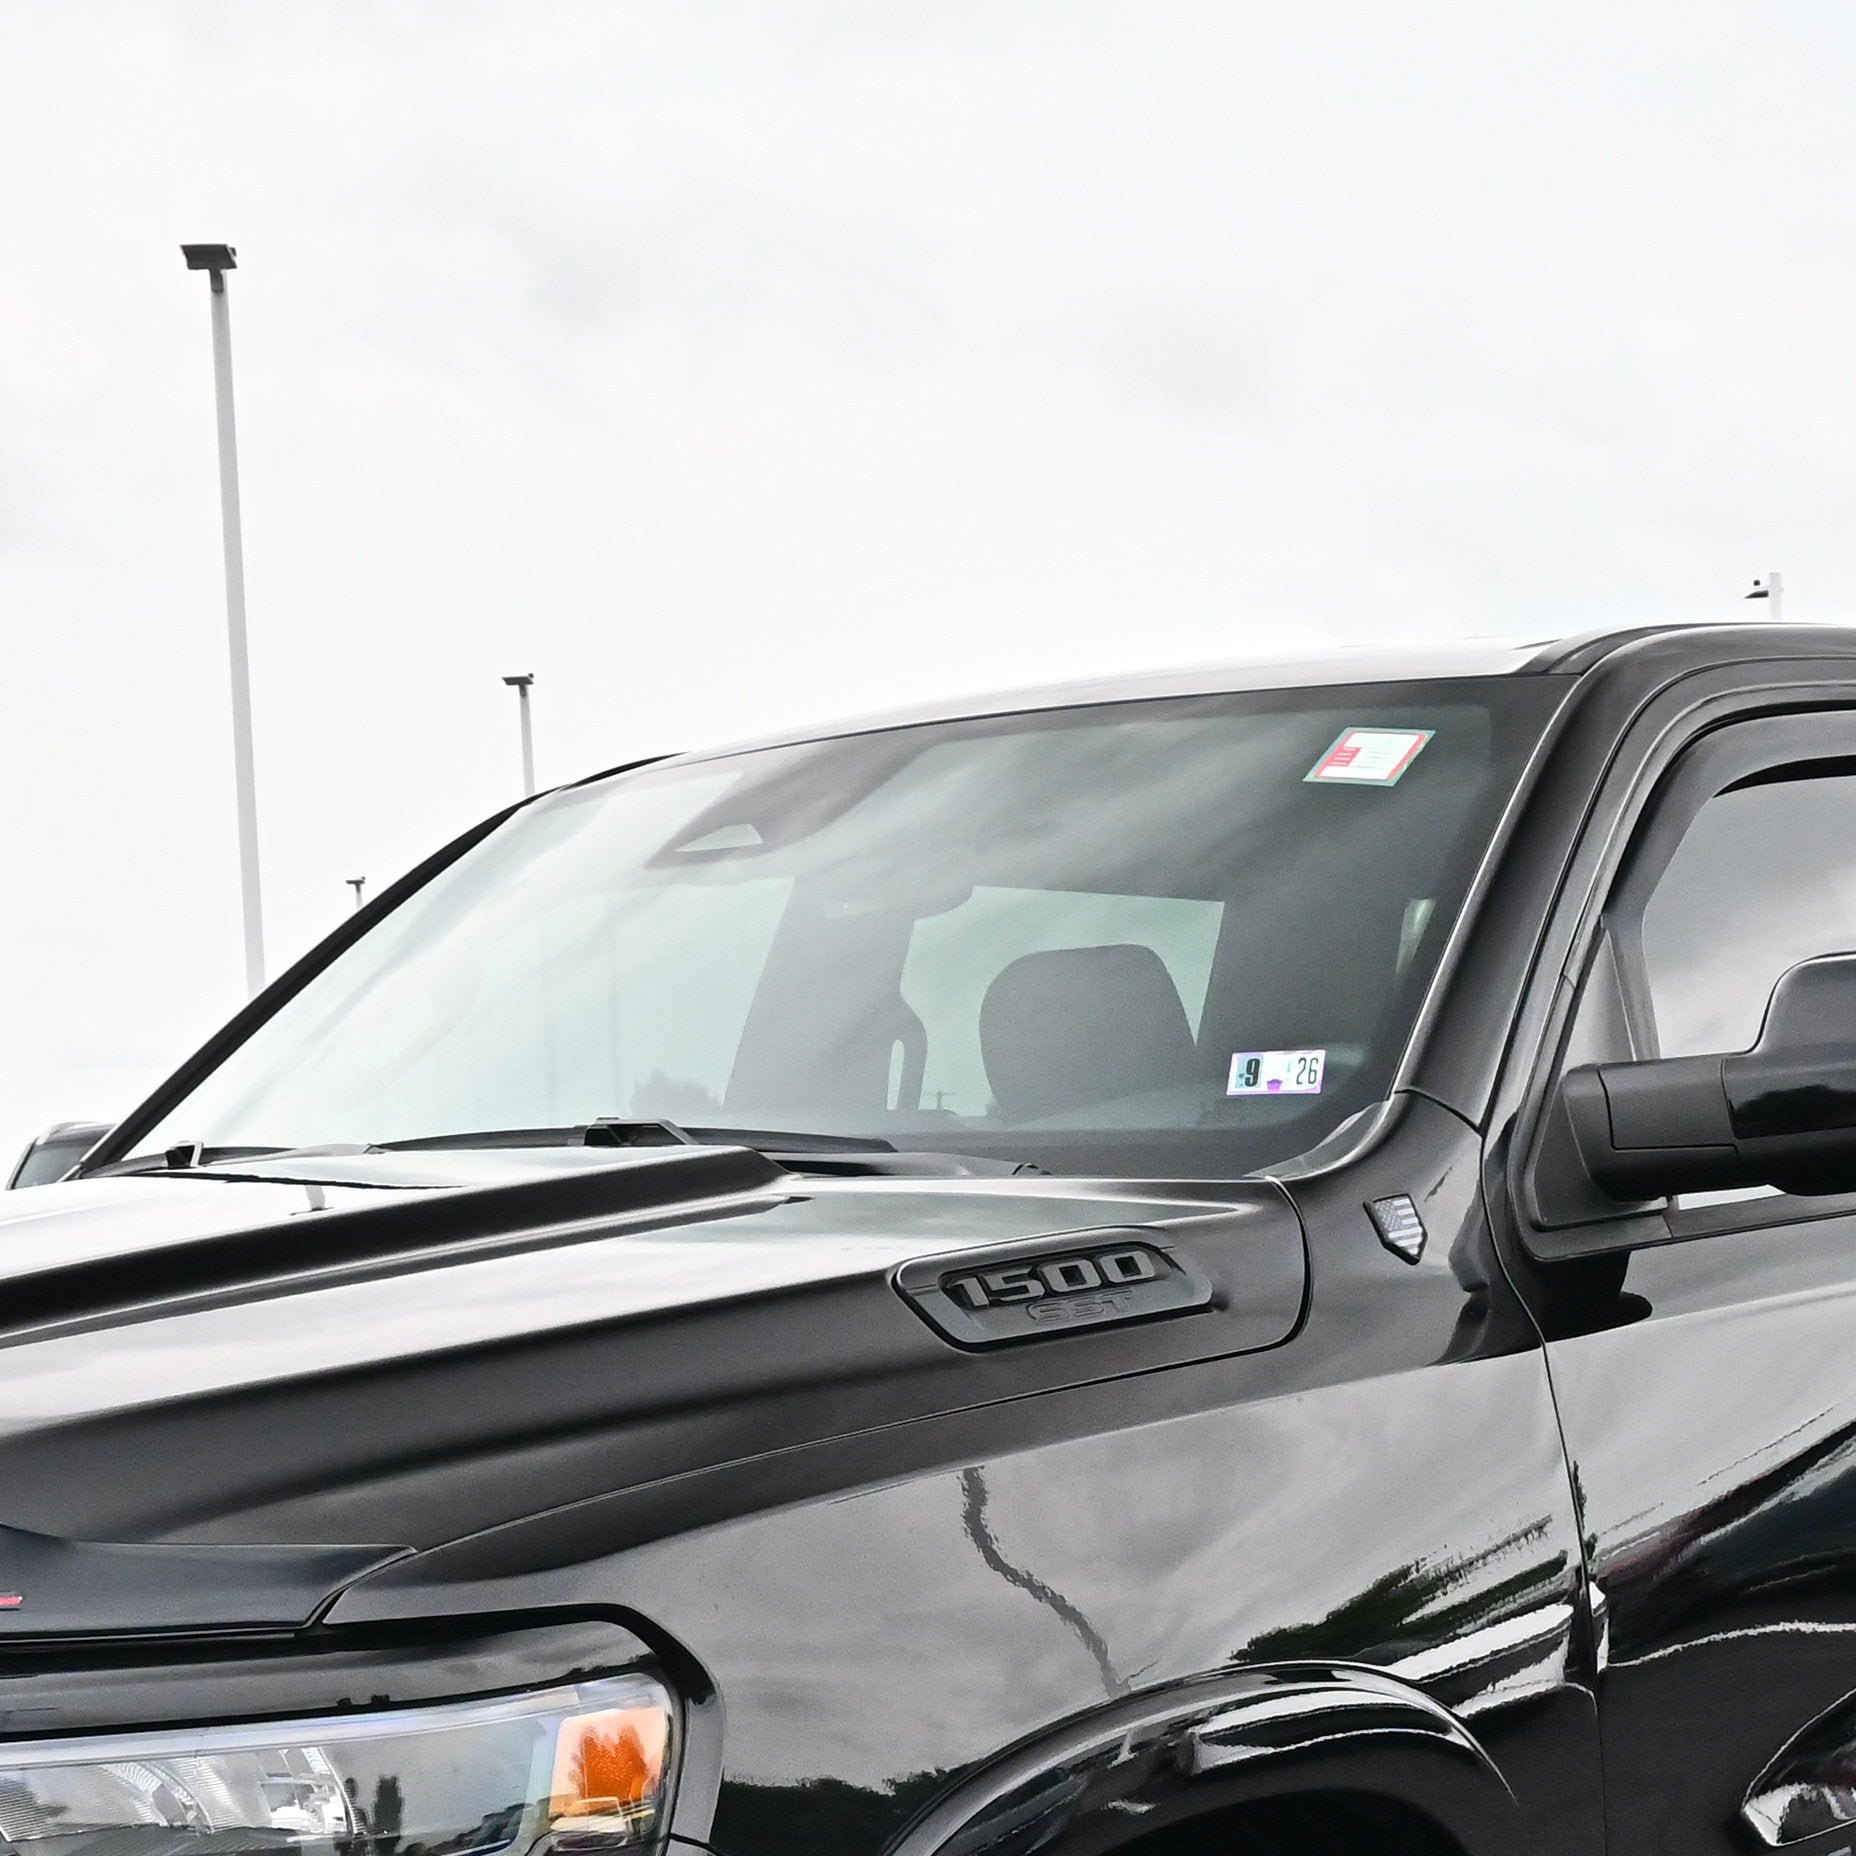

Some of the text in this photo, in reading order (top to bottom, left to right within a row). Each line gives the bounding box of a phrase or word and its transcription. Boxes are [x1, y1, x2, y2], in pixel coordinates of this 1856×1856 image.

[1245, 1057, 1319, 1087] 9 26
[950, 1250, 1156, 1308] 1500
